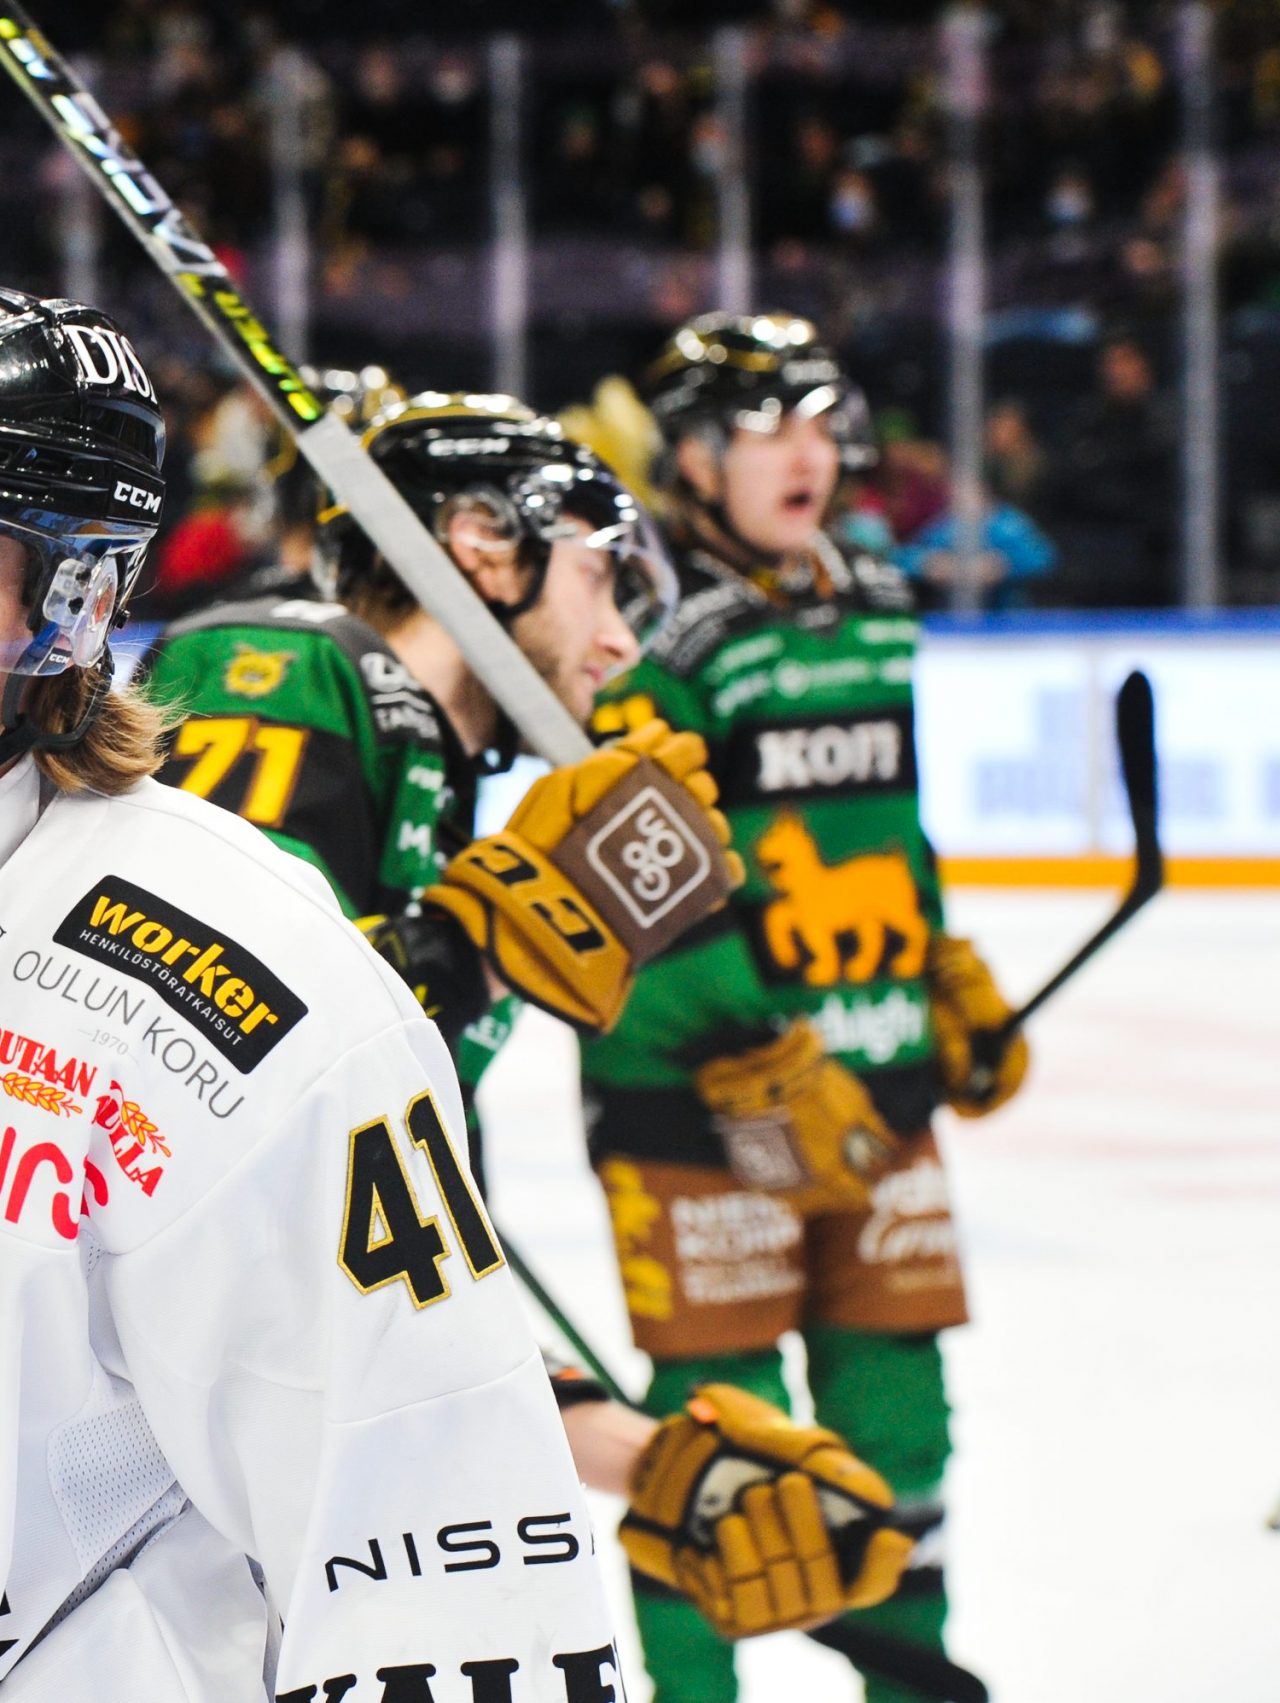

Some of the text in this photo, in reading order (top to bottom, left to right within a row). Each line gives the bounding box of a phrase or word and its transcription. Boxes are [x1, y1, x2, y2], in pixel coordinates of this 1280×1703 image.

[61, 324, 158, 406] DIS
[113, 480, 162, 514] CCM
[173, 715, 312, 829] 71
[78, 928, 244, 1048] HENKILÖSTÖRATKAISUT
[88, 894, 279, 1035] worker
[12, 949, 246, 1120] OULUN KORU
[336, 1087, 507, 1312] 41
[324, 1510, 596, 1593] NISS
